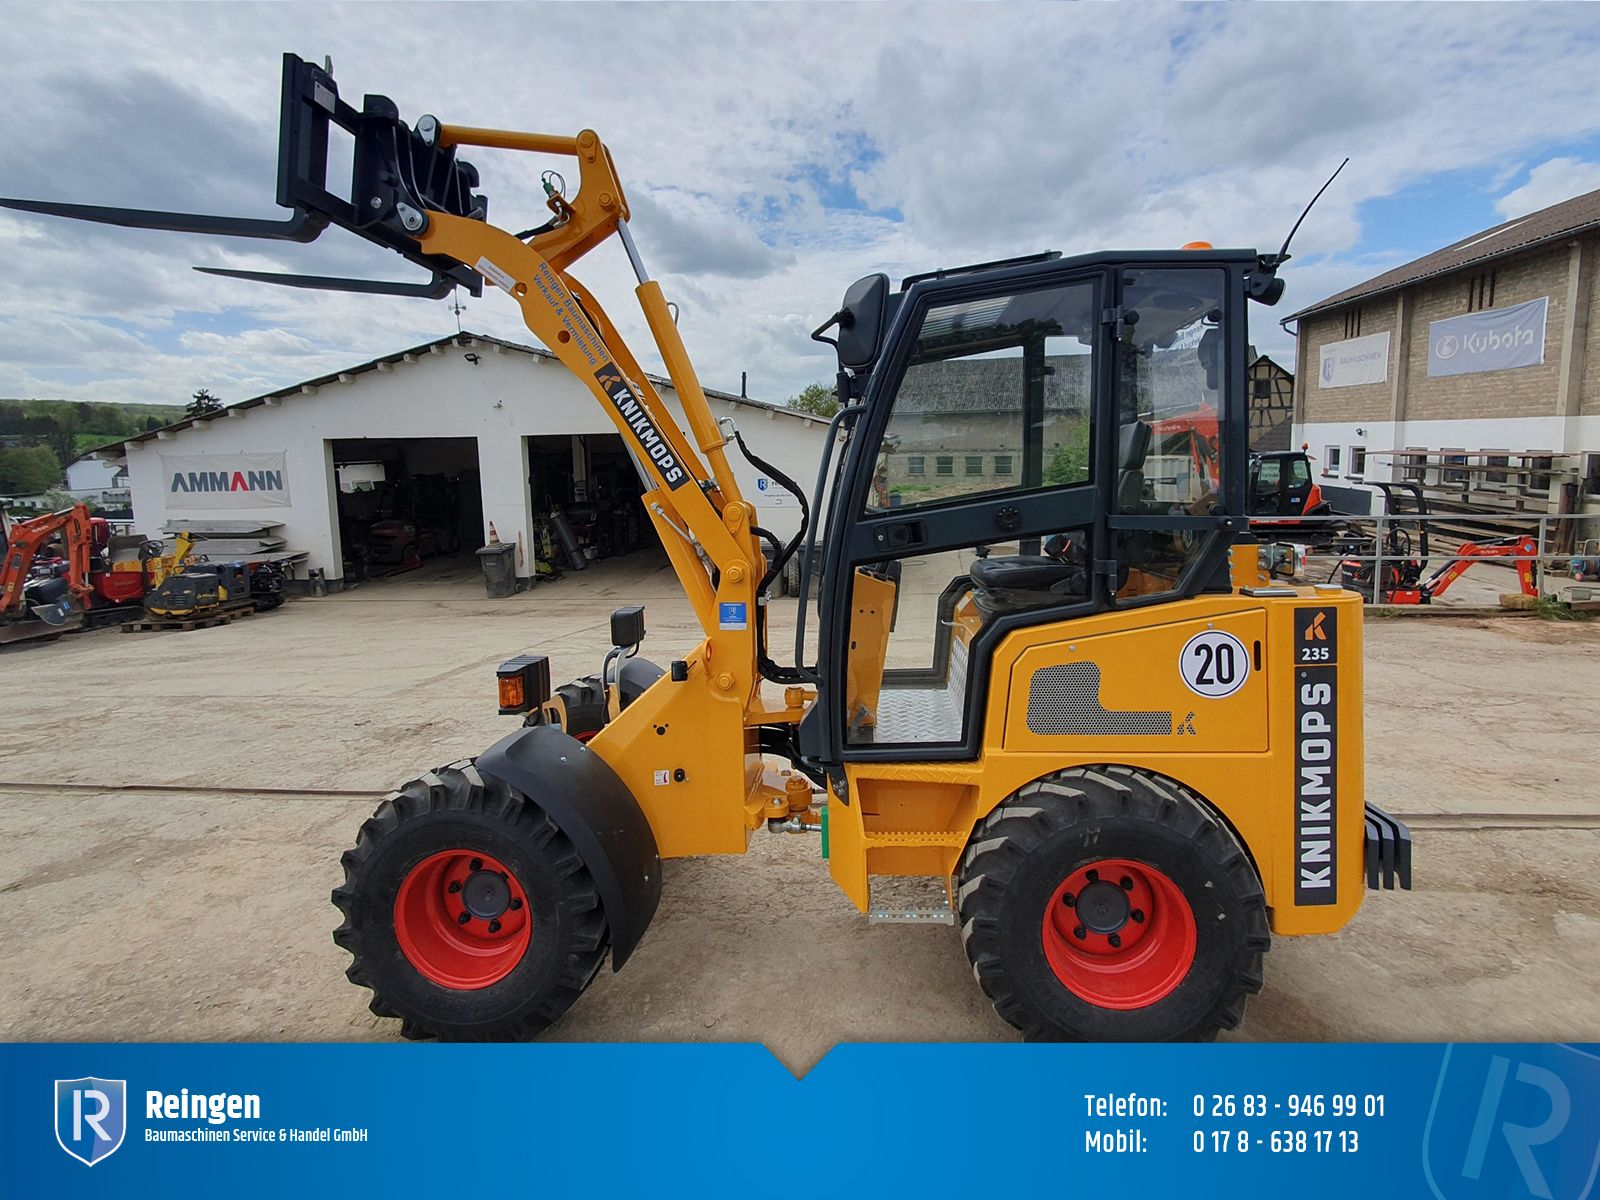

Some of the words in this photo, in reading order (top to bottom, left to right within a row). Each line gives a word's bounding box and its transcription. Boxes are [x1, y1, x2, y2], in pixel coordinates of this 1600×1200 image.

[533, 274, 560, 308] Verkauf
[556, 307, 564, 316] &
[562, 315, 597, 366] Vermietung
[539, 262, 565, 299] Reingen
[563, 298, 609, 361] Baumaschinen
[1463, 325, 1534, 353] Kubota
[613, 388, 683, 483] KNIKMOPS
[171, 470, 283, 492] AMMANN
[1193, 643, 1235, 685] 20
[1302, 647, 1329, 661] 235
[1301, 683, 1331, 889] KNIKMOPS
